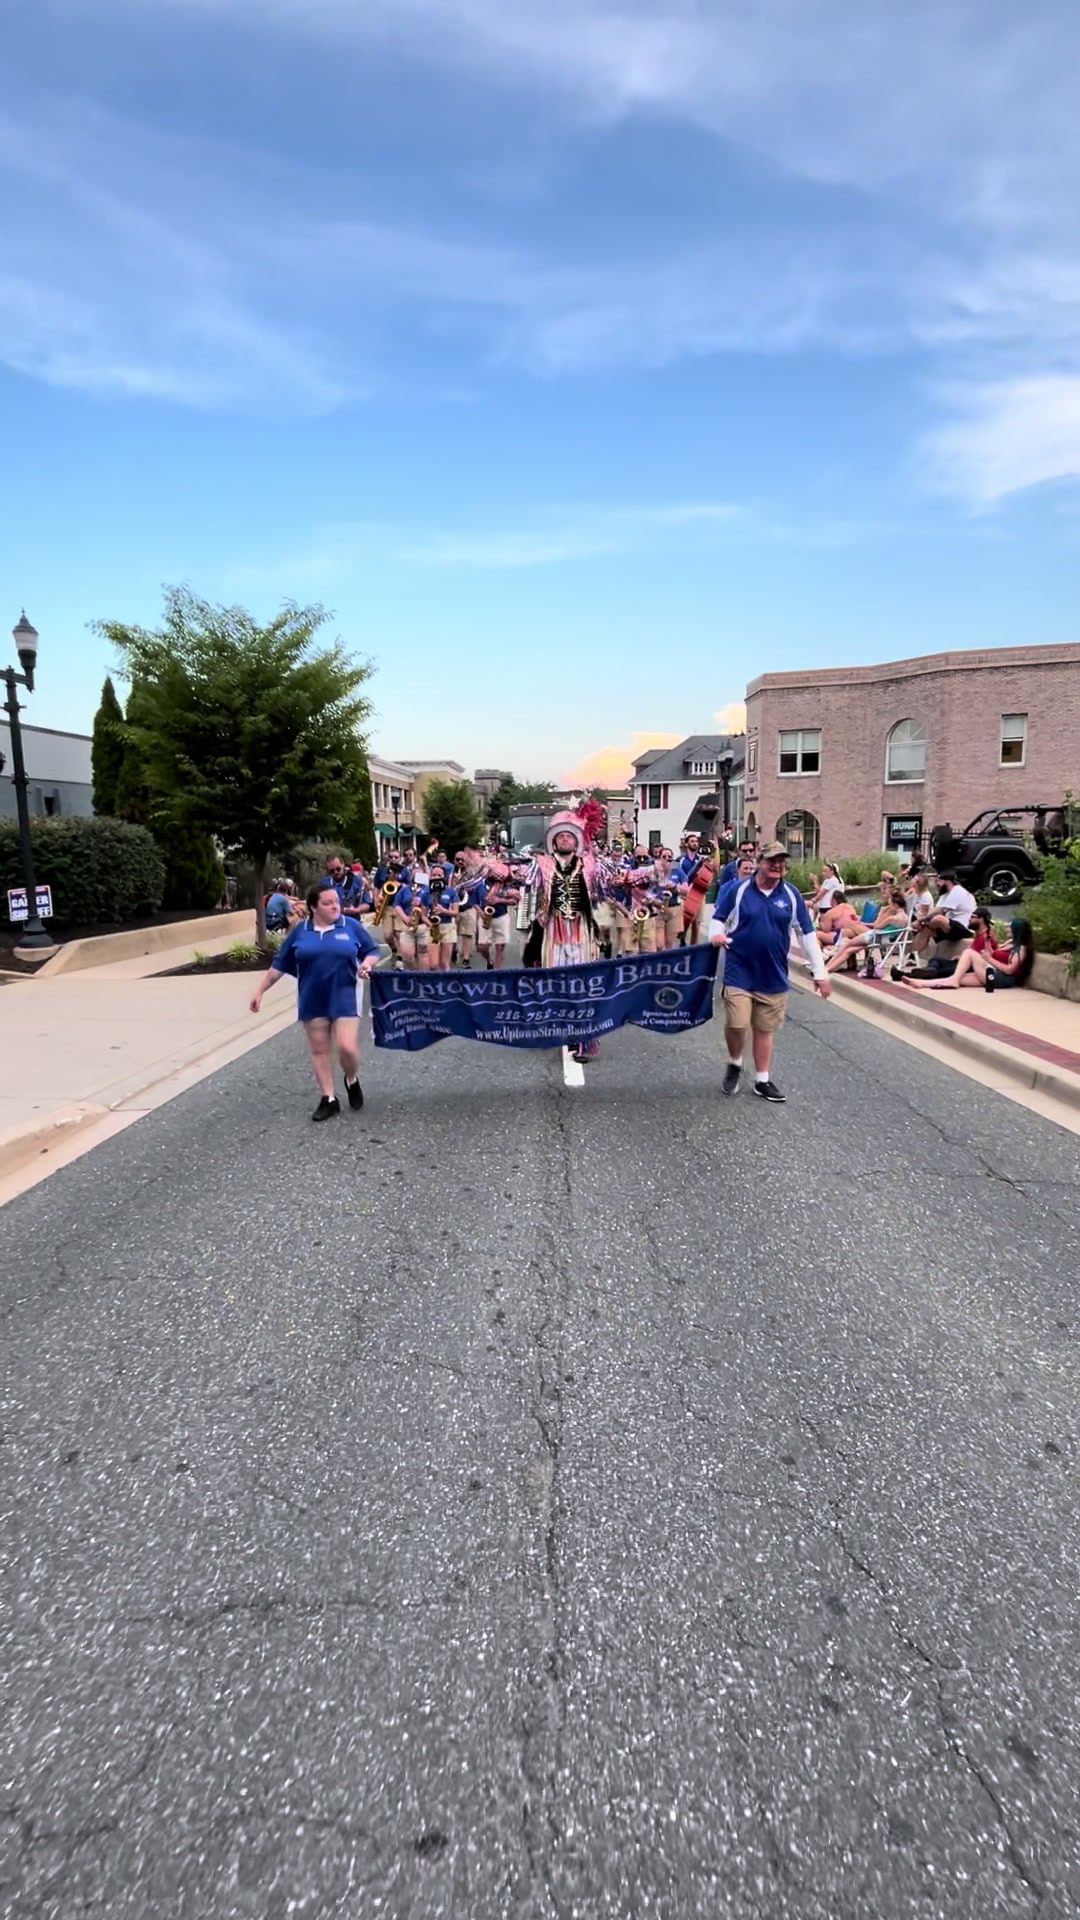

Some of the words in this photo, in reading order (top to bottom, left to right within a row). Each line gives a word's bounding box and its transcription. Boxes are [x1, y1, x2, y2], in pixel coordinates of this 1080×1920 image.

[392, 977, 508, 998] Uptown
[518, 973, 606, 998] String
[616, 955, 692, 987] Band
[475, 1018, 614, 1042] www.UptownStringBand.com
